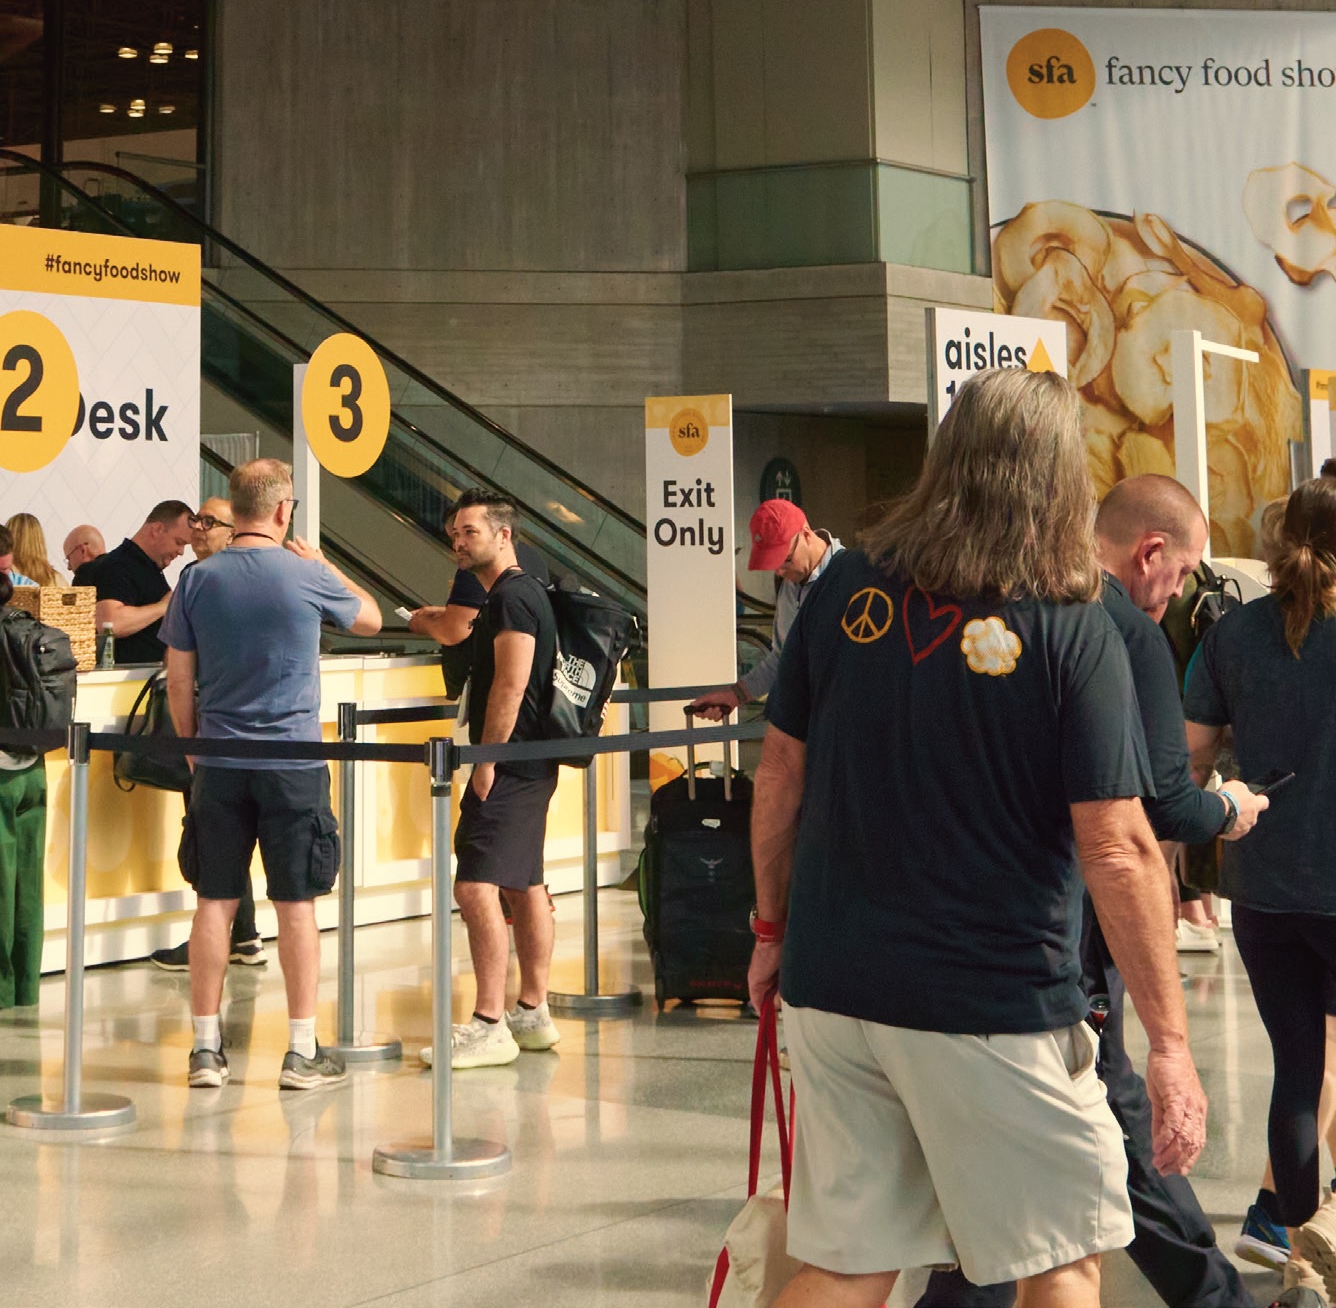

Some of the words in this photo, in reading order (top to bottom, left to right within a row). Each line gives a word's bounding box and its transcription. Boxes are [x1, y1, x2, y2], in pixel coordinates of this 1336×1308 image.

[1027, 56, 1077, 85] sfa
[1105, 56, 1193, 93] fancy
[1201, 59, 1272, 87] food
[45, 254, 181, 284] #fancyfoodshow
[945, 327, 1028, 371] aisles
[1, 344, 44, 432] 2
[328, 364, 363, 443] 3
[72, 388, 169, 442] esk
[678, 423, 700, 439] sfa
[663, 478, 716, 508] Exit
[654, 518, 724, 555] Only
